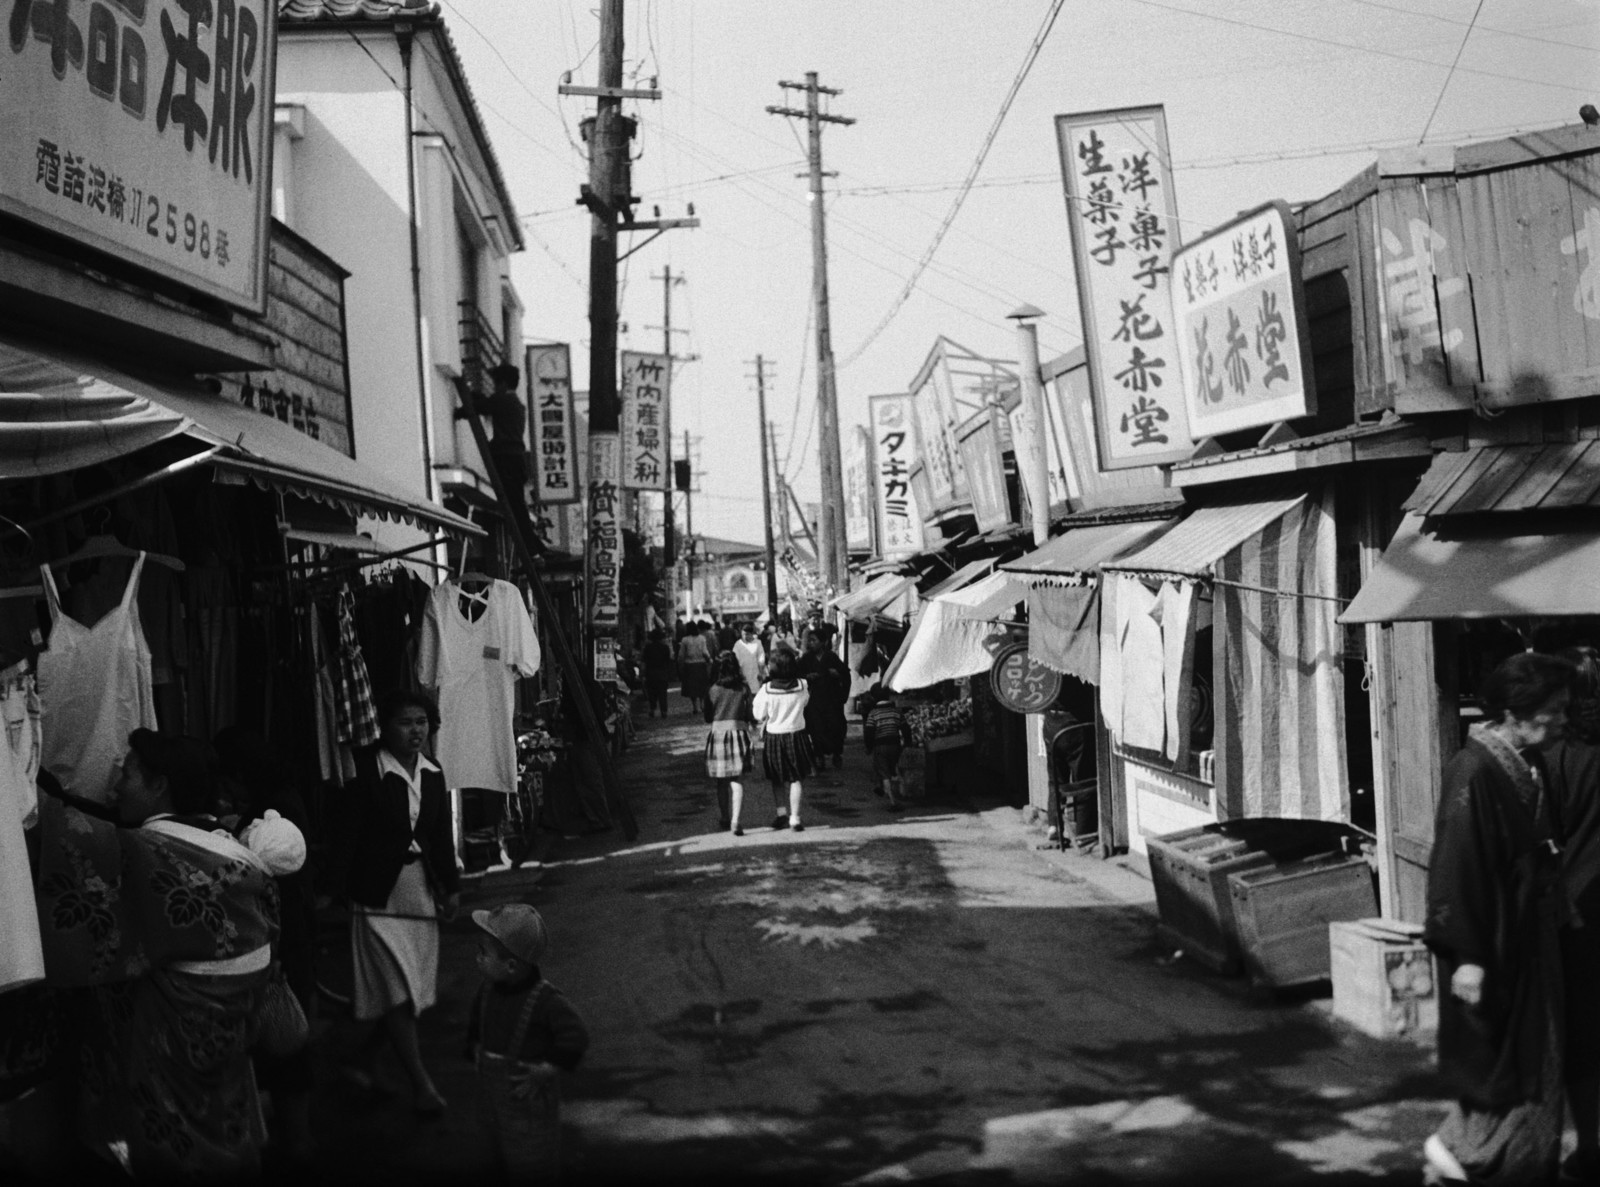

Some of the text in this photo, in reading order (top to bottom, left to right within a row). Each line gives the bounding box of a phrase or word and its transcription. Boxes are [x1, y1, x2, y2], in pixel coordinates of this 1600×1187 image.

[1079, 129, 1125, 266] 生菓子
[1118, 151, 1169, 290] 洋菓子
[633, 358, 665, 484] 竹内産婦人科
[880, 431, 909, 518] タキカミ
[1007, 654, 1023, 701] コロッケ
